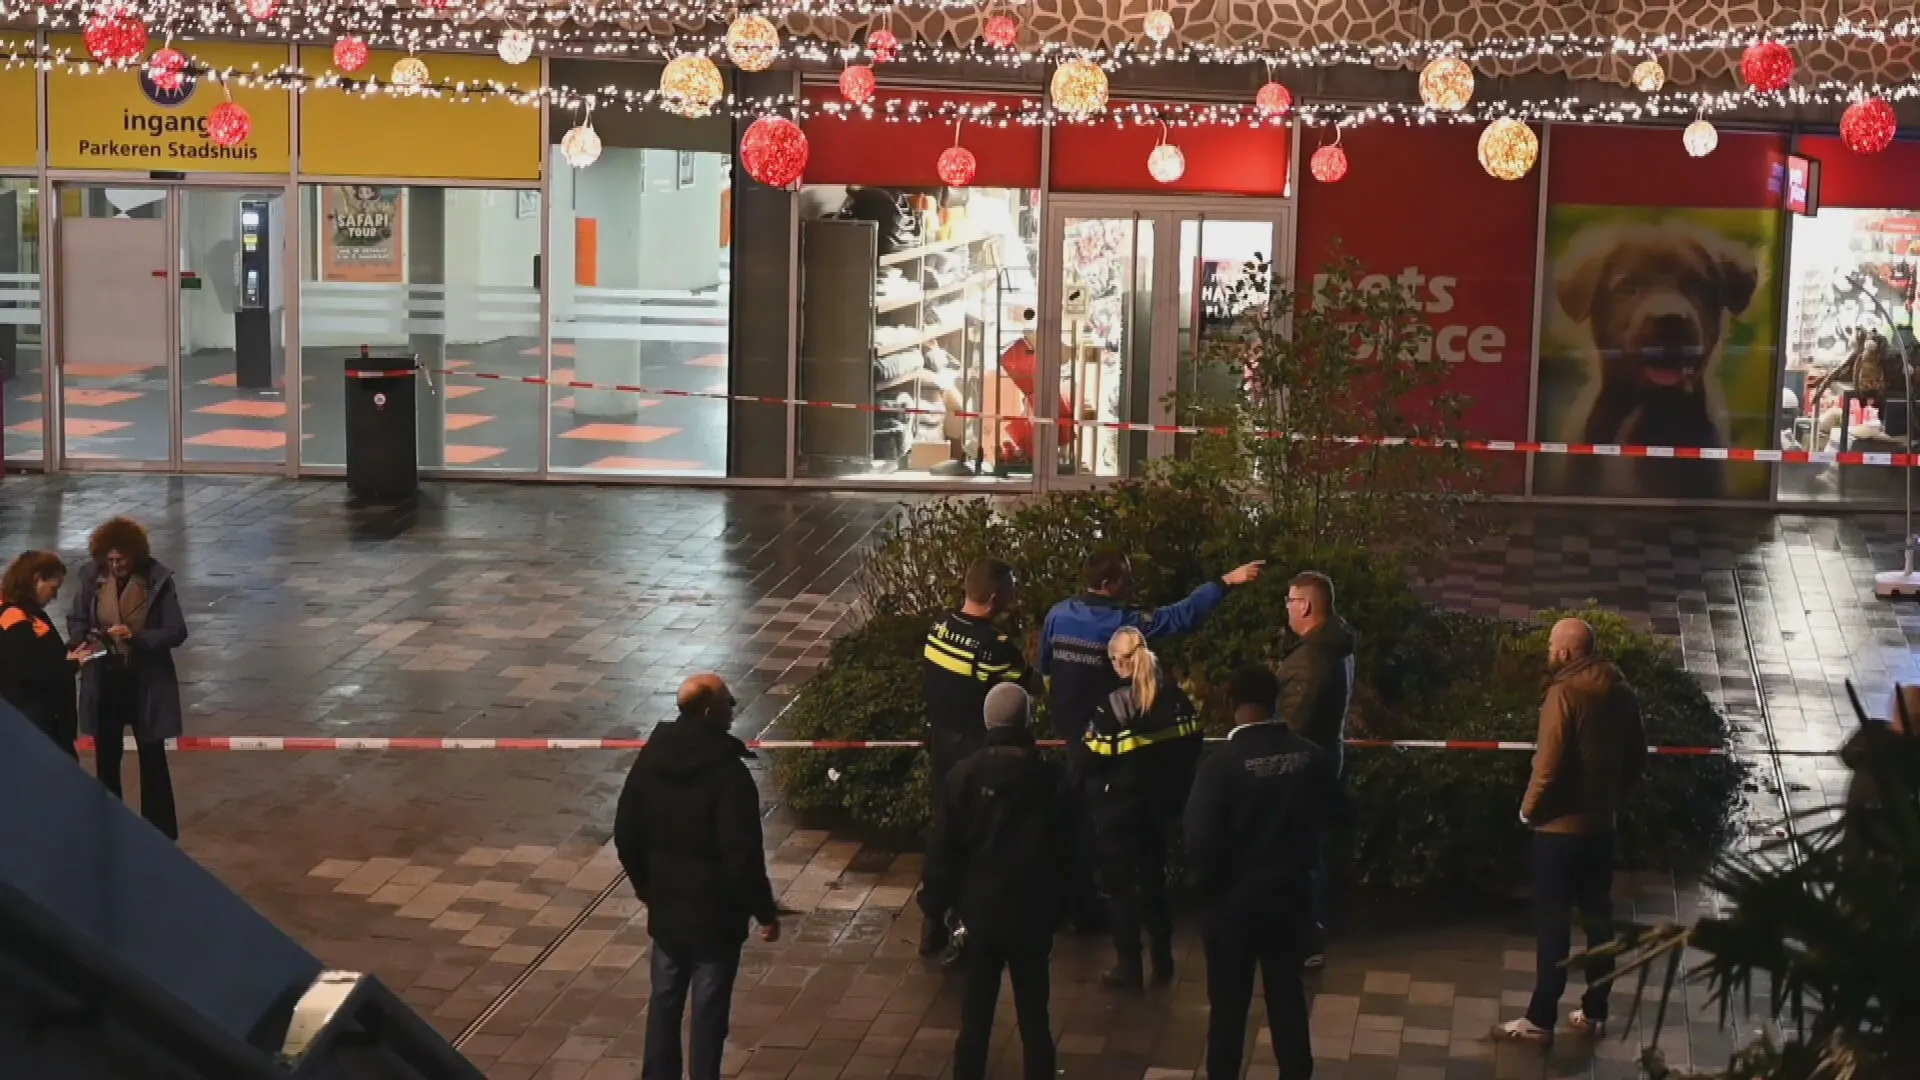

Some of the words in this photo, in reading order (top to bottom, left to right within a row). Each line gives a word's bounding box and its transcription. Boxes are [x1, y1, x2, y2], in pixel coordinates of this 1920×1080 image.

[79, 140, 161, 157] Parkeren
[168, 142, 258, 160] Stadshuis
[338, 213, 389, 227] SAFARI
[348, 227, 377, 237] TOUR
[1312, 266, 1457, 322] pets
